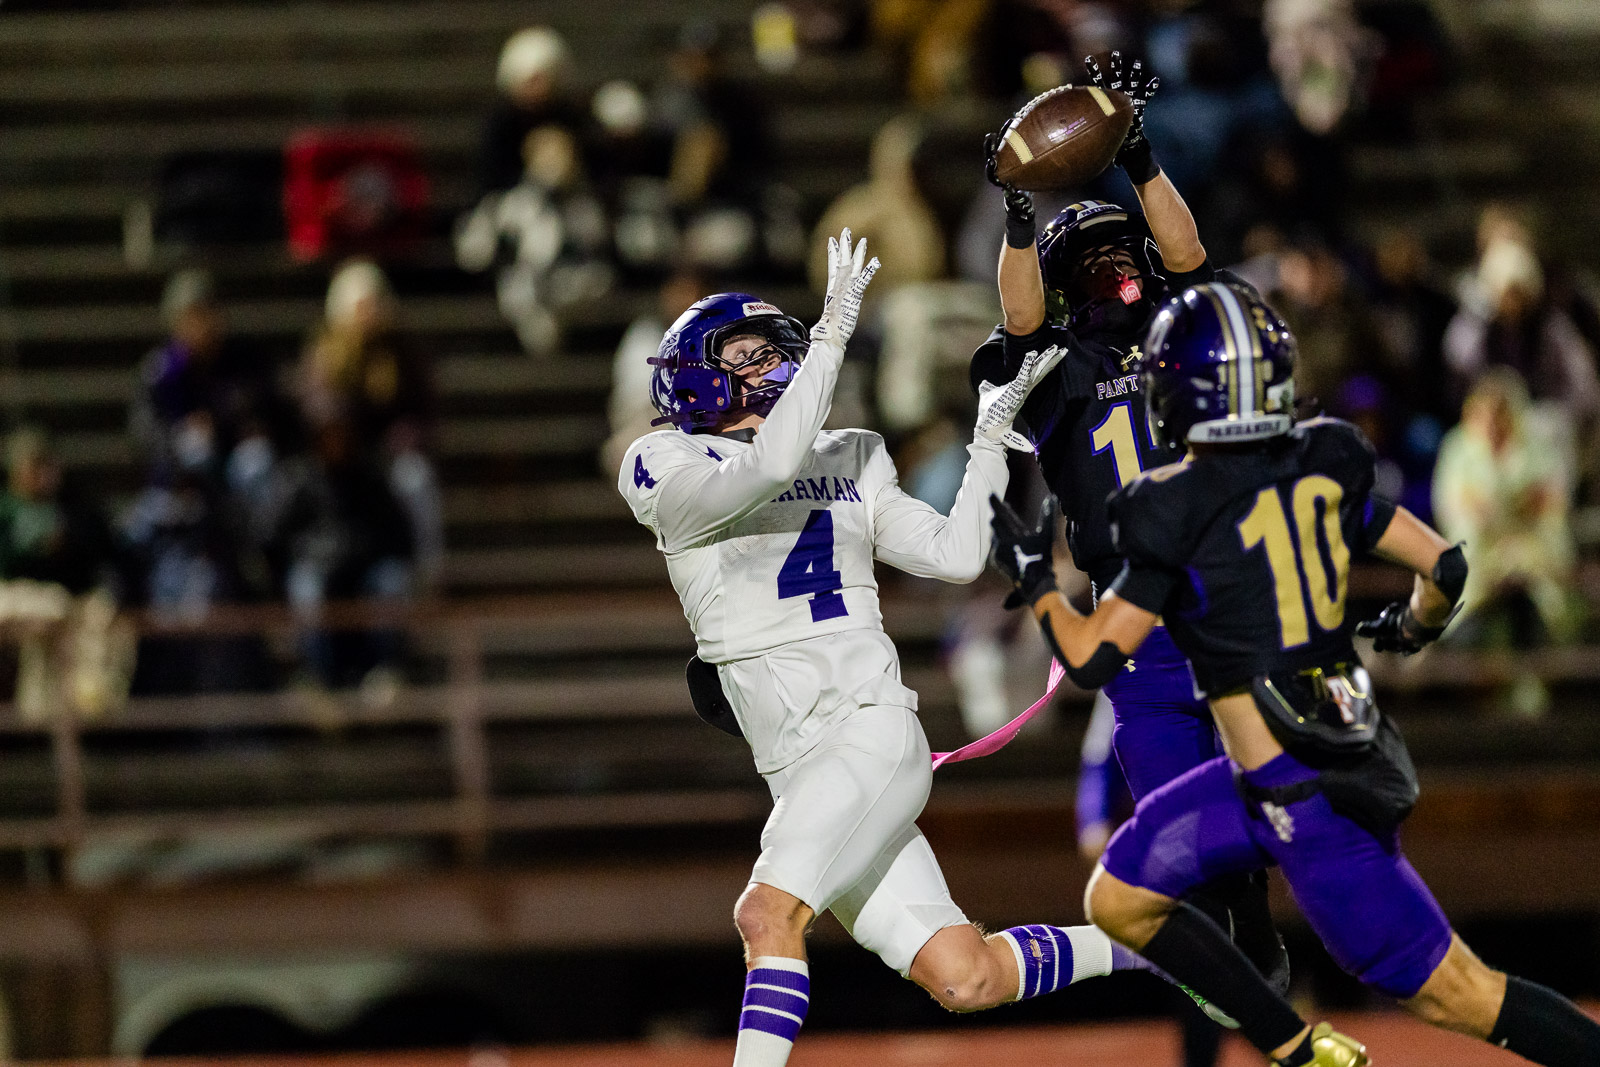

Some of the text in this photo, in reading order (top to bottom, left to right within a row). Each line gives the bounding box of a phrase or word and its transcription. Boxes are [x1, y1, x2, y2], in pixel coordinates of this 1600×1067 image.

[1095, 374, 1139, 400] PANT
[634, 453, 657, 489] 4
[1088, 400, 1159, 490] 1
[770, 476, 862, 503] ARMAN
[777, 509, 850, 623] 4
[1235, 473, 1351, 650] 10
